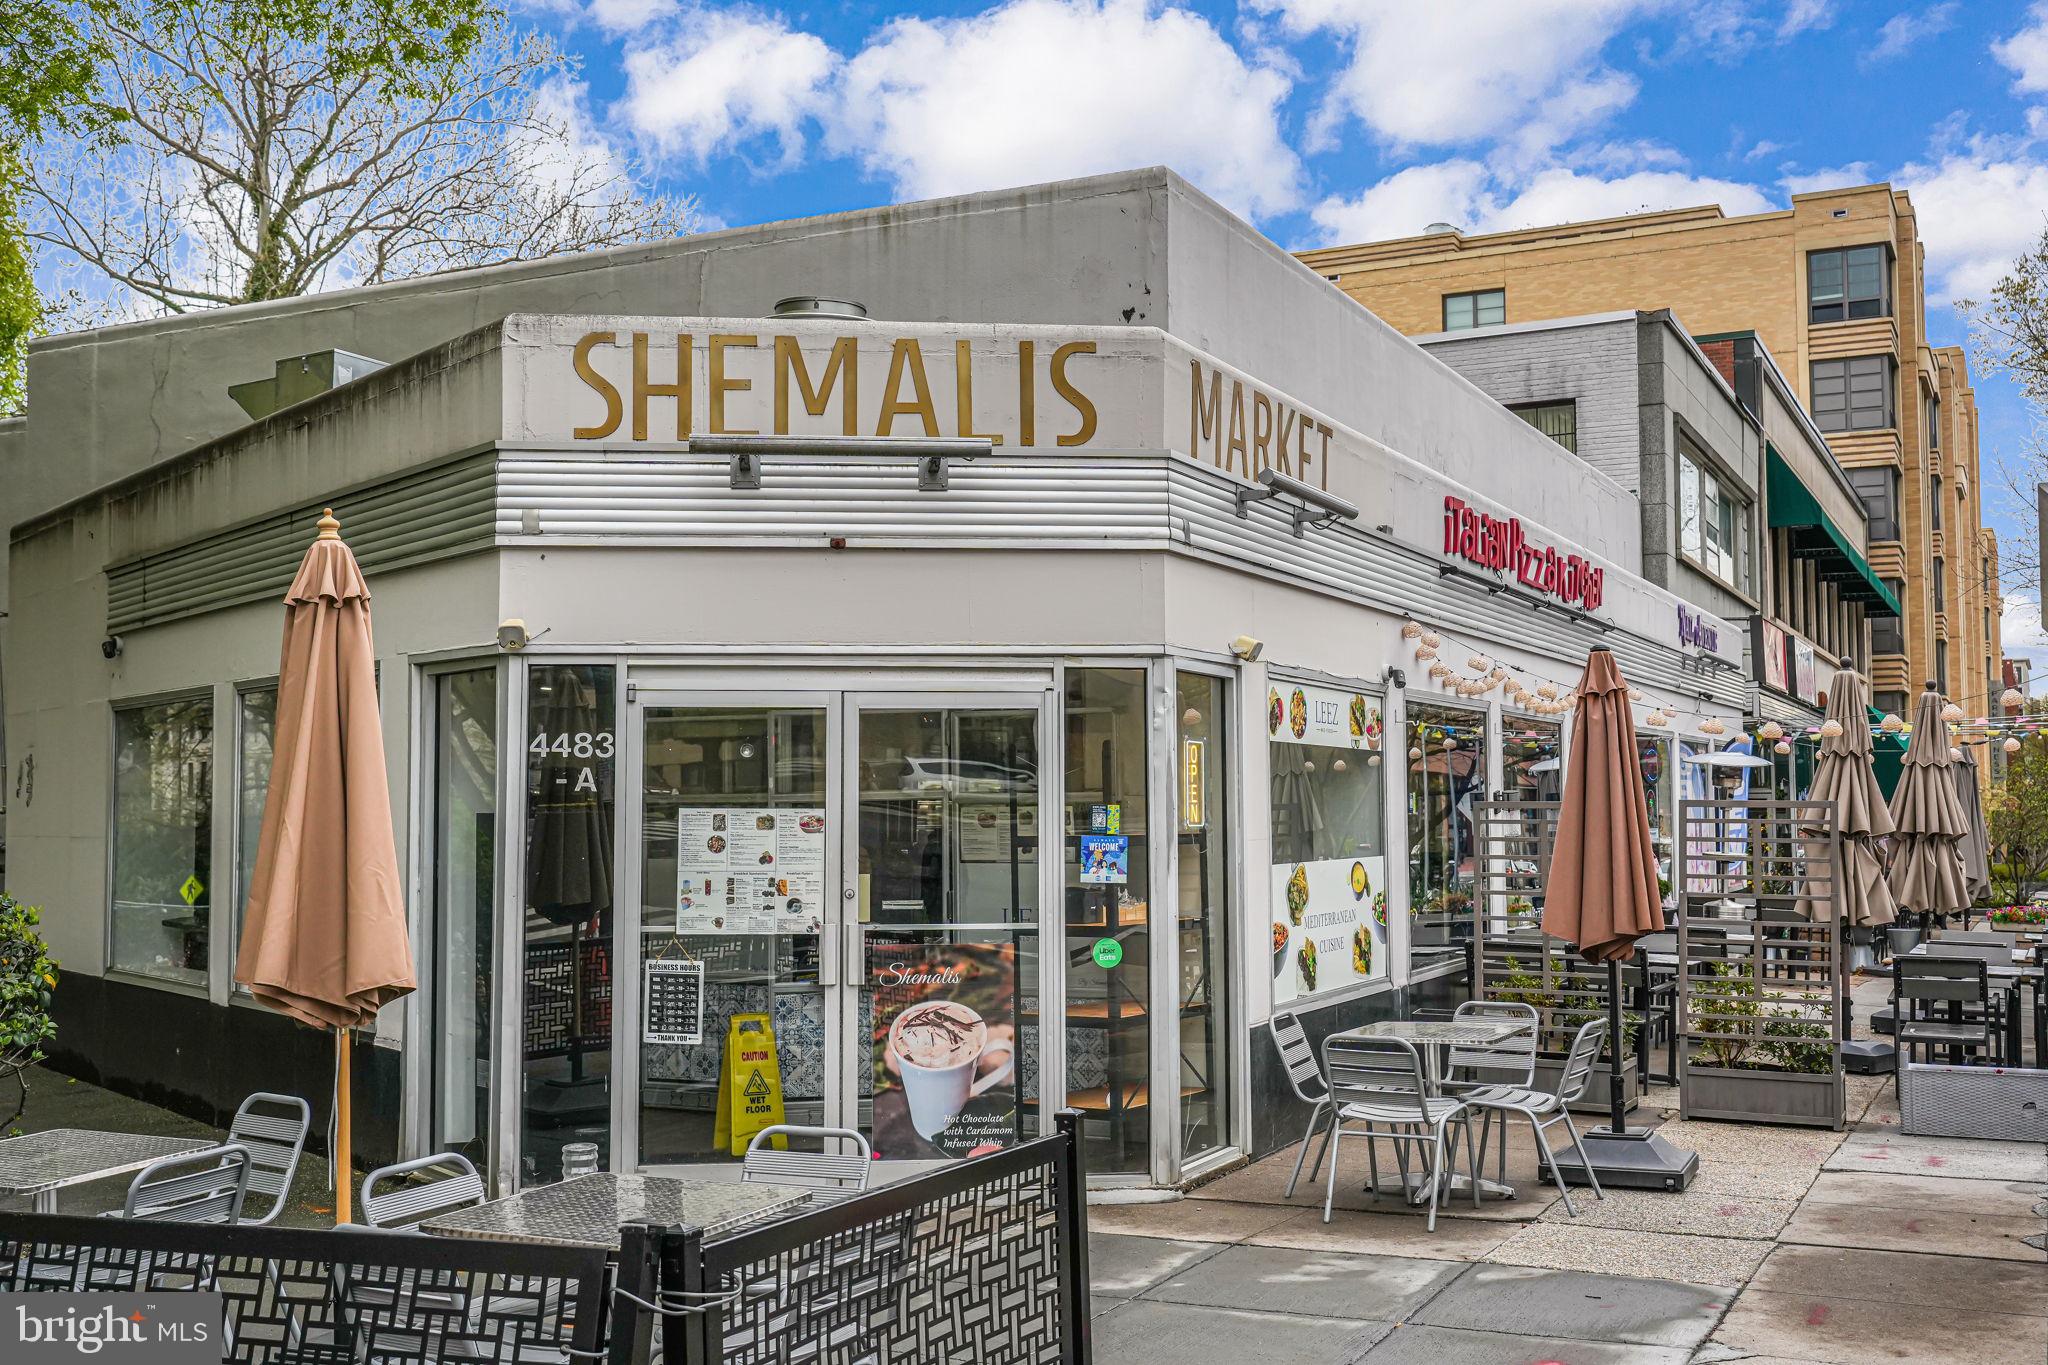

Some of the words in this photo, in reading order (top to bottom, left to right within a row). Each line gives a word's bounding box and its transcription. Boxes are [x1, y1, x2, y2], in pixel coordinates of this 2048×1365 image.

[573, 331, 1098, 447] SHEMALIS
[1190, 358, 1335, 492] MARKET
[1315, 700, 1339, 726] LEEZ
[529, 732, 615, 758] 4483
[1190, 744, 1199, 823] OPEN
[1088, 842, 1119, 851] WELCOME
[1303, 908, 1357, 930] MEDITERRANEAN
[1319, 936, 1345, 954] CUISINE
[648, 963, 679, 971] BUSINESS
[679, 964, 701, 972] HOURS
[879, 962, 961, 987] Shemalis
[657, 1034, 676, 1042] THANK
[741, 1050, 769, 1062] CAUTION
[749, 1096, 766, 1104] WET
[745, 1104, 772, 1114] FLOOR
[943, 1114, 960, 1123] Hot
[961, 1112, 1004, 1123] Chocolate
[943, 1126, 964, 1136] with
[965, 1125, 1013, 1135] Cardamom
[943, 1137, 978, 1149] Infused
[979, 1137, 1003, 1148] Whip
